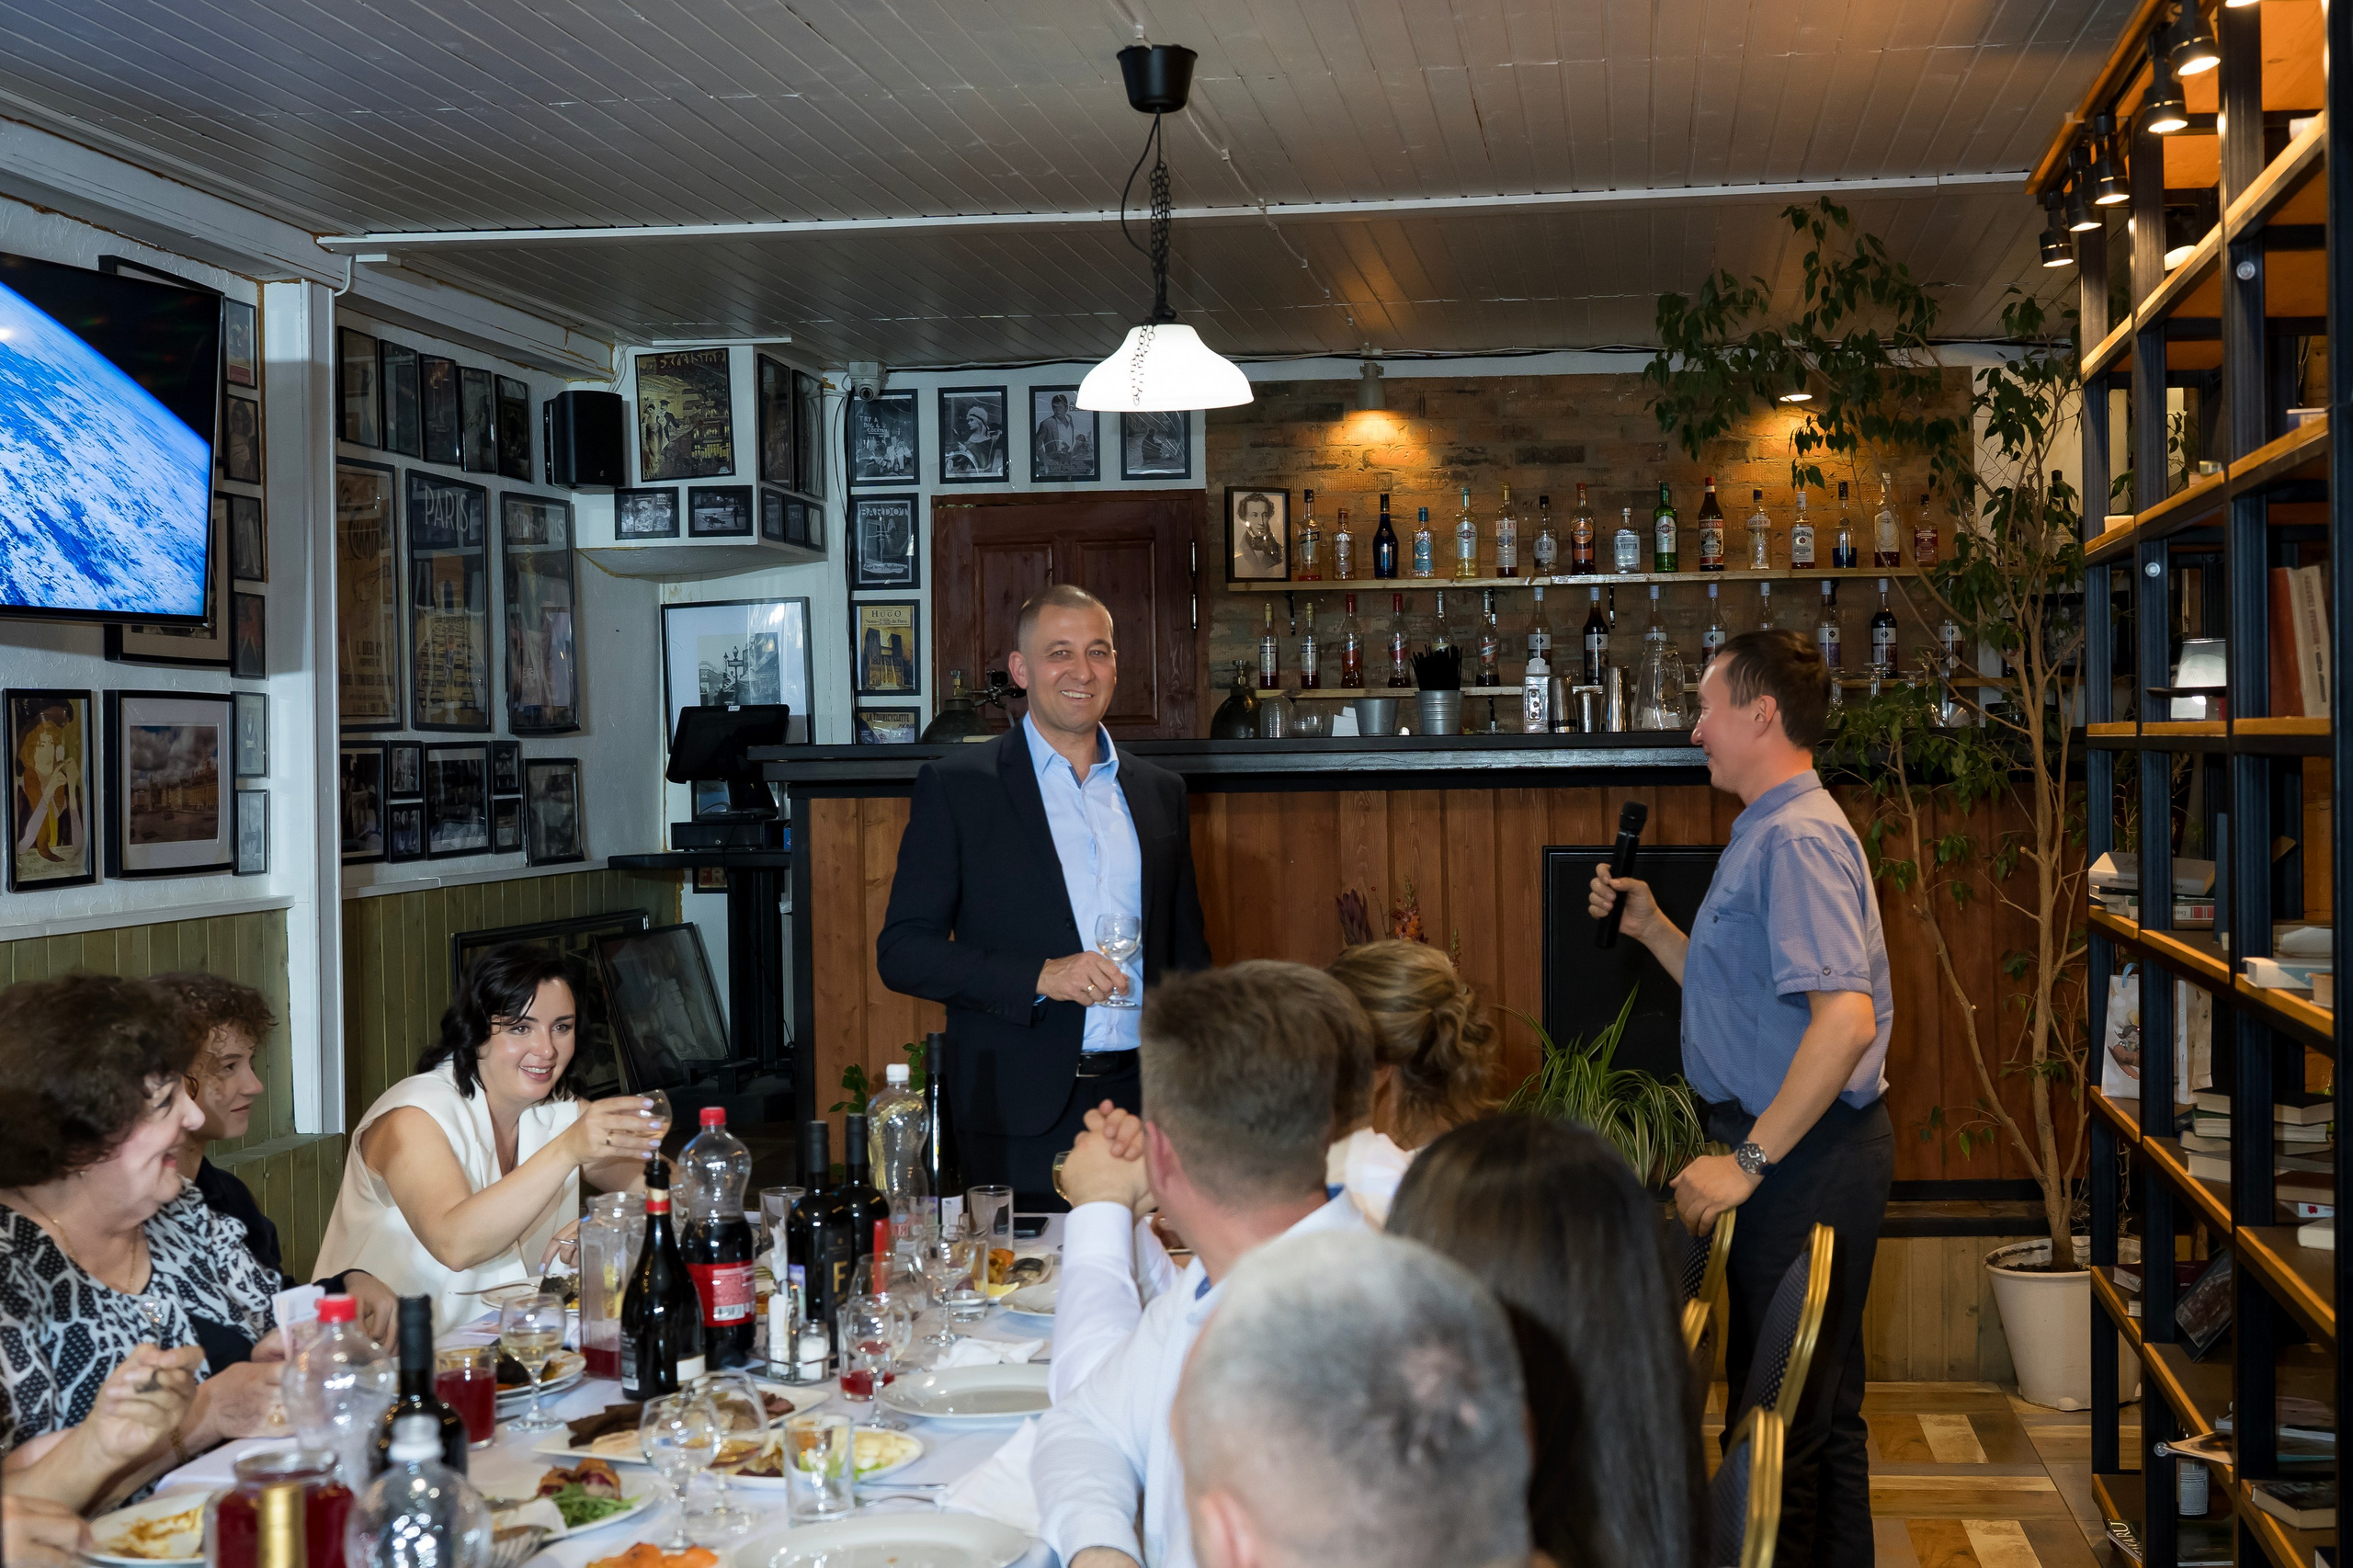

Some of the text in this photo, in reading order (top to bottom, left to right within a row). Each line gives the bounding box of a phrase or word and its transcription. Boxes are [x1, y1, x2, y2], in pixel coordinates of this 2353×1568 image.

[425, 485, 468, 533] PARIS
[860, 507, 908, 517] BARDOT
[871, 609, 902, 618] HUGO
[833, 1260, 848, 1293] F
